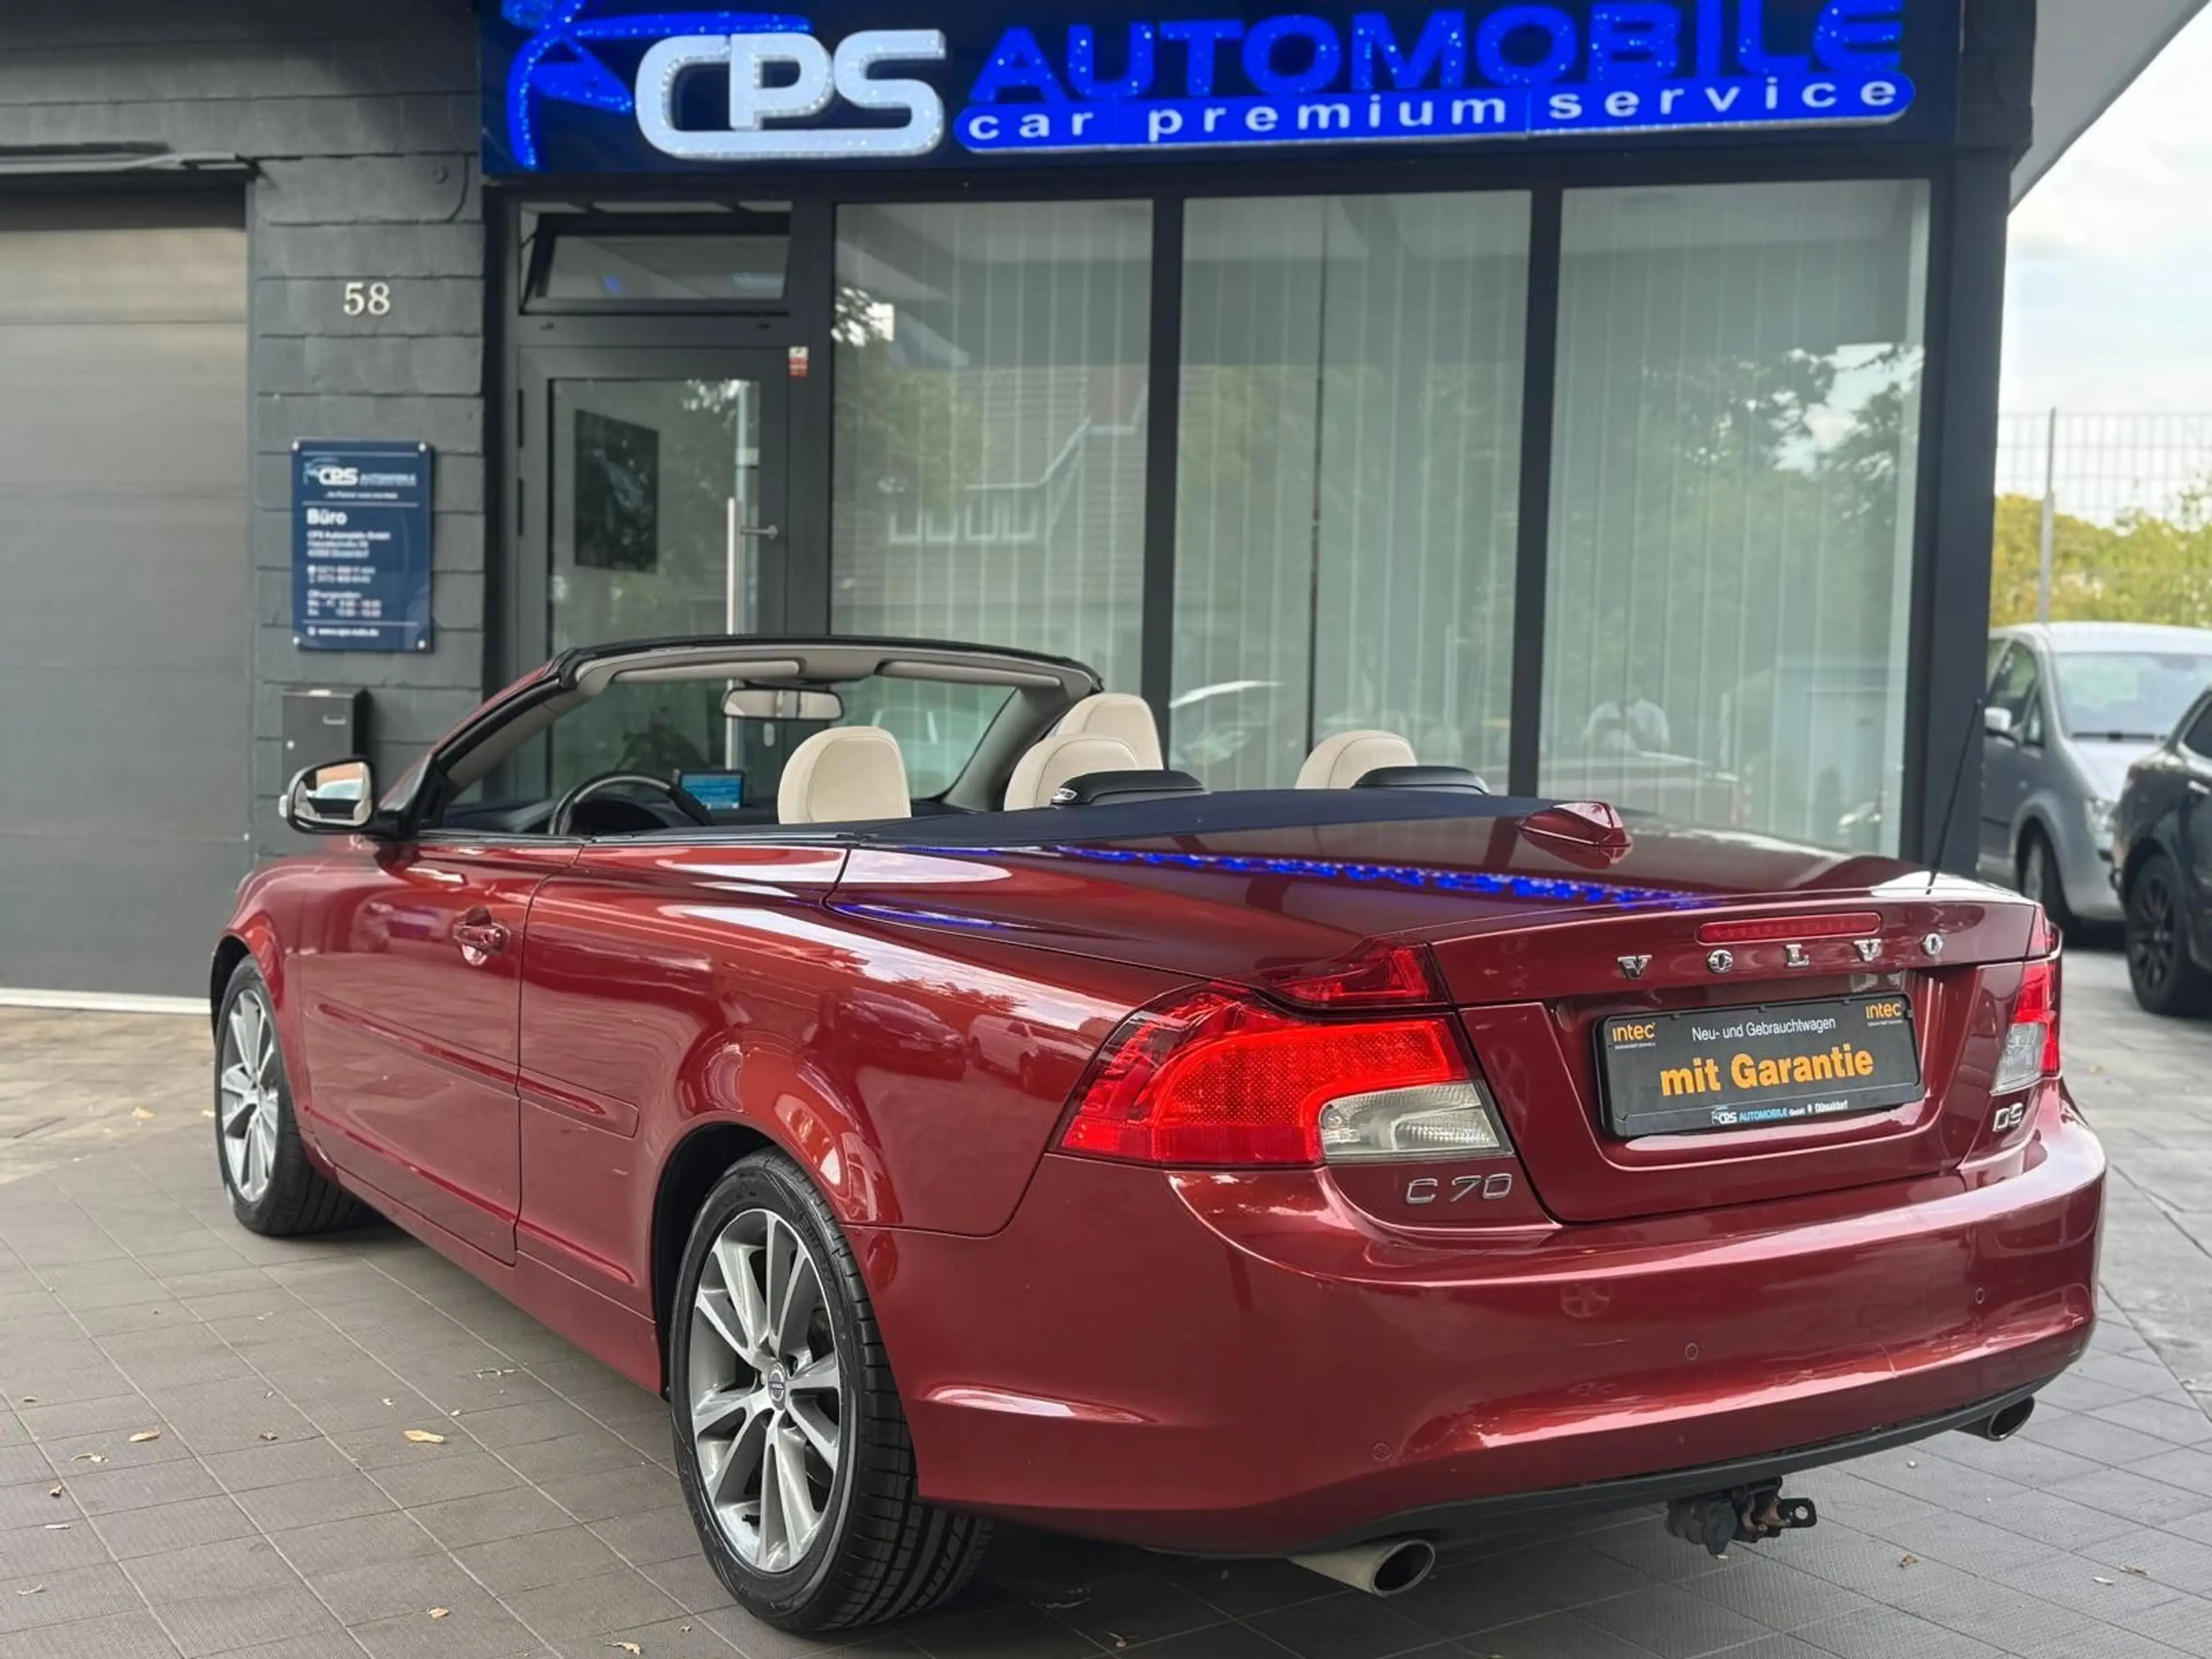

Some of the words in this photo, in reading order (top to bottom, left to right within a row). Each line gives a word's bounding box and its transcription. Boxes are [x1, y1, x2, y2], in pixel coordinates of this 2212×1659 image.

[635, 29, 945, 160] CPS
[969, 0, 1903, 103] AUTOMOBILE
[968, 111, 1093, 140] car
[1148, 94, 1506, 143] premium
[1549, 77, 1897, 119] service
[343, 281, 390, 316] 58
[307, 508, 348, 525] Büro
[1617, 933, 1944, 979] VOLVO
[1865, 1002, 1902, 1019] intec
[1612, 1024, 1655, 1042] intec
[1692, 1027, 1719, 1041] Neu-
[1722, 1023, 1744, 1039] und
[1746, 1017, 1836, 1036] Gebrauchtwagen
[1660, 1058, 1721, 1096] mit
[1731, 1043, 1874, 1089] Garantie
[1739, 1107, 1787, 1122] AUTOMOBILE
